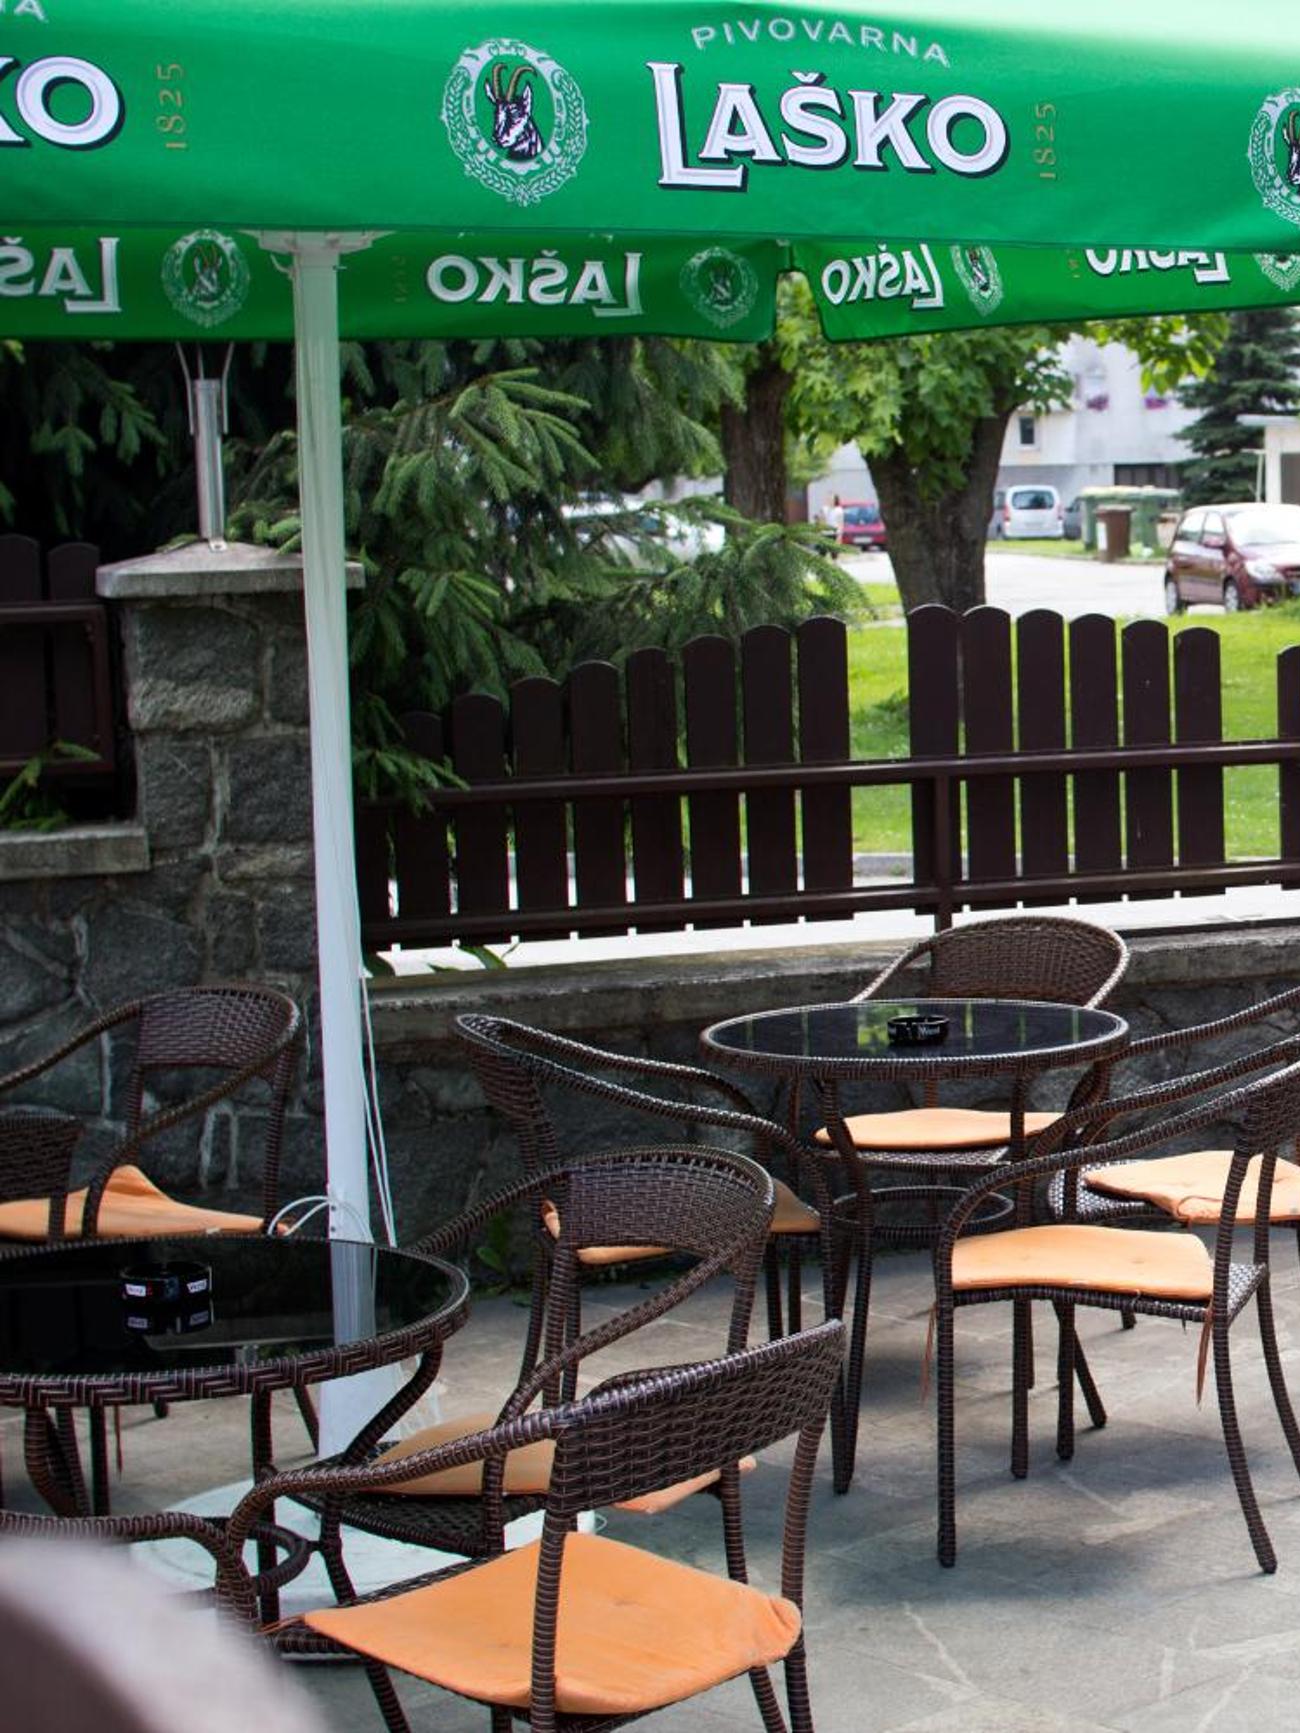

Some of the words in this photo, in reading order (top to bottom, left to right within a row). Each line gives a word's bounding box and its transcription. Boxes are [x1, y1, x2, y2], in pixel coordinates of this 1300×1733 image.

[690, 17, 951, 69] PIVOVARNA
[156, 63, 188, 150] 1825
[646, 61, 1009, 190] LAŠKO
[1032, 102, 1057, 181] 1825
